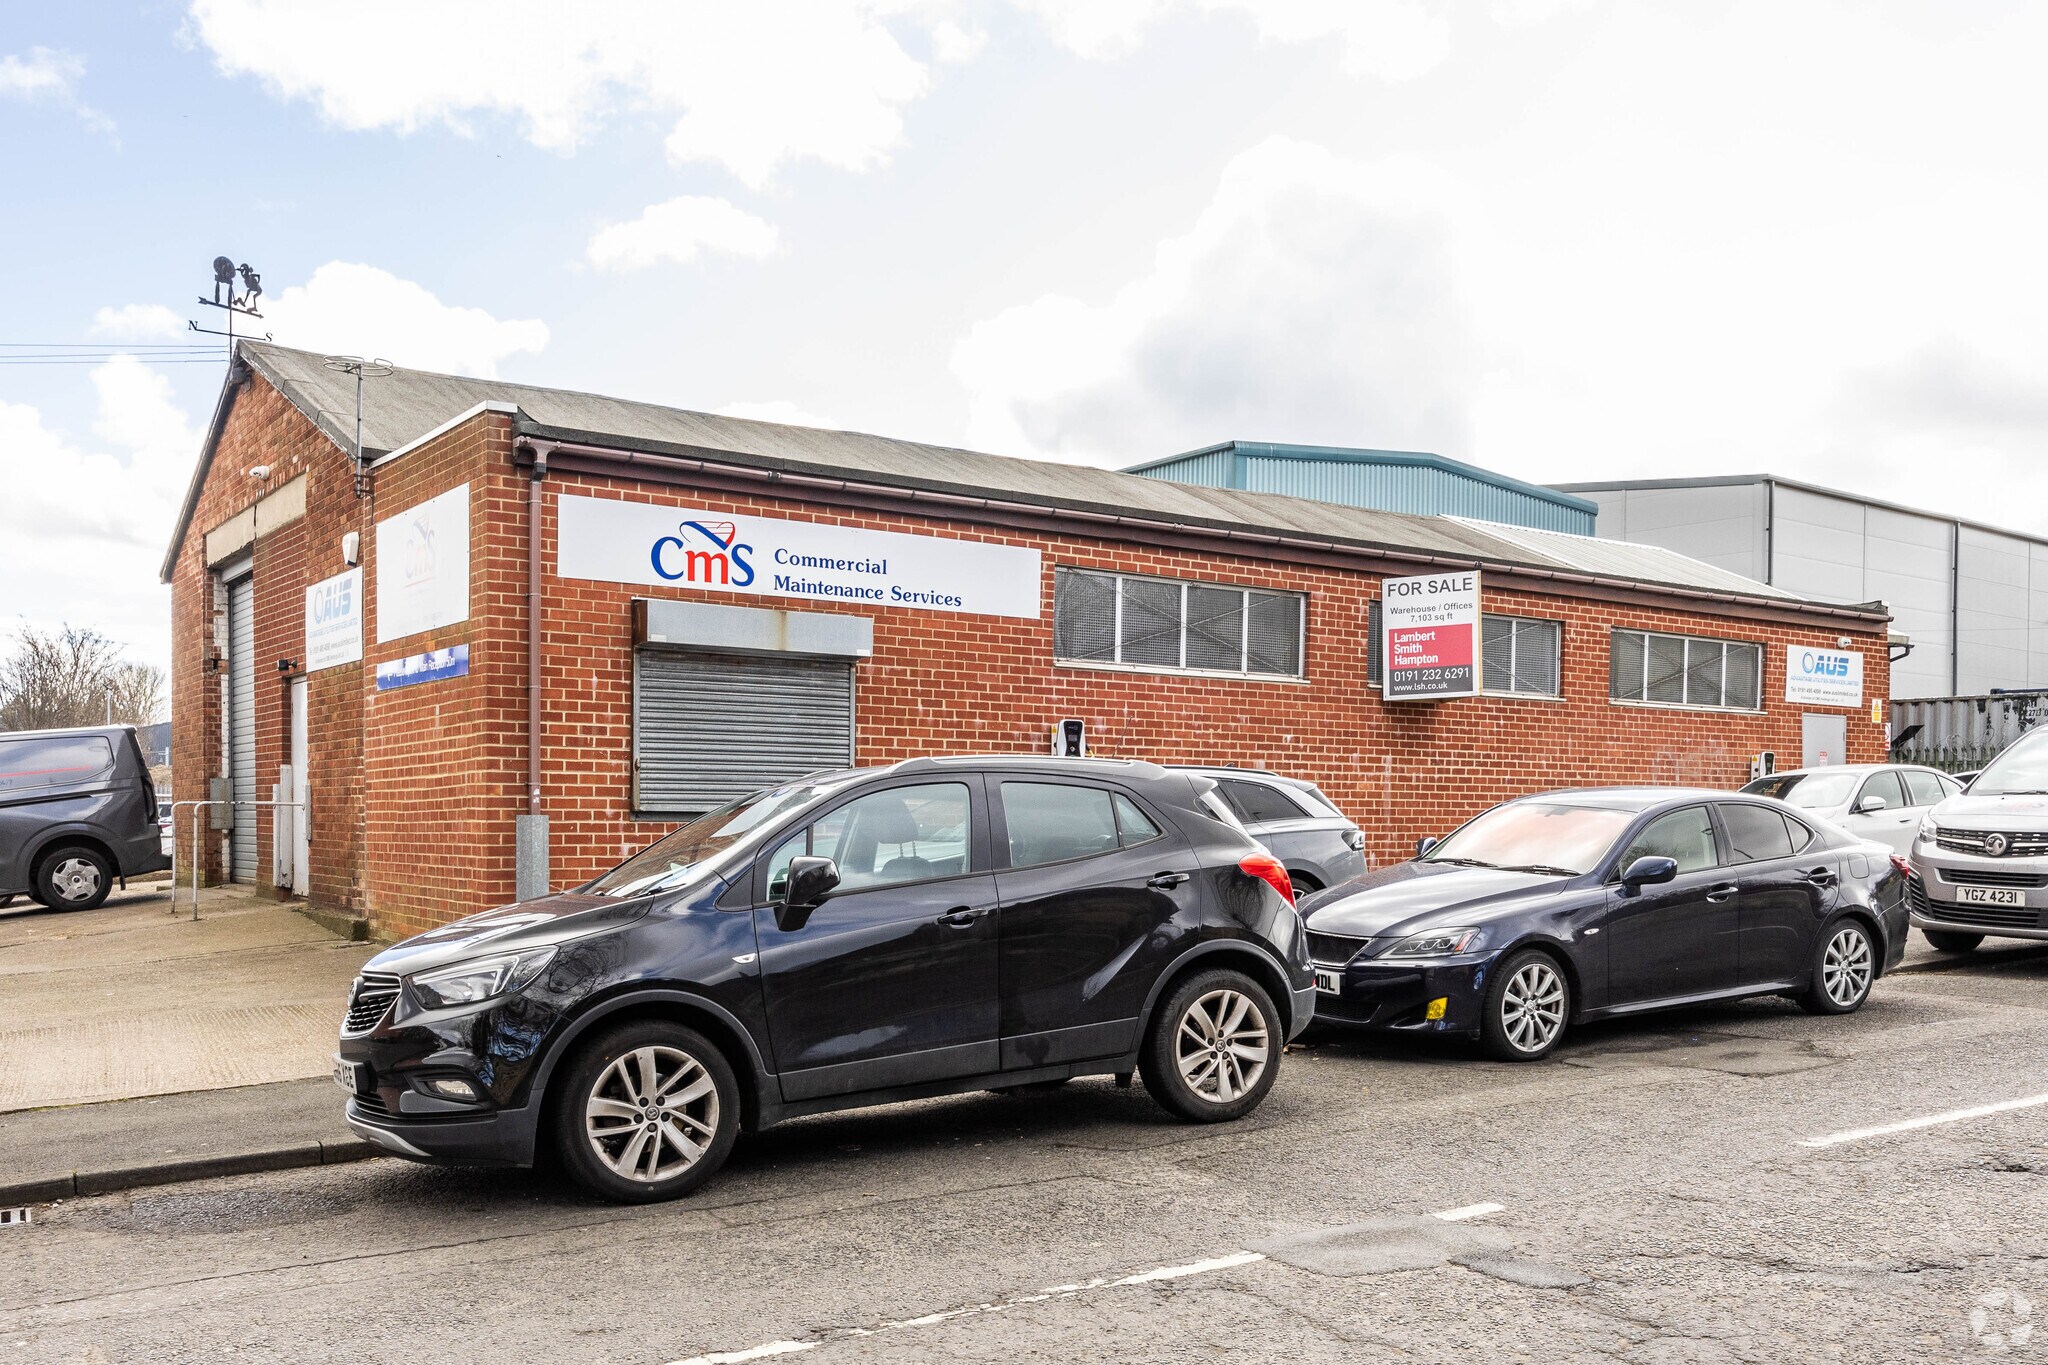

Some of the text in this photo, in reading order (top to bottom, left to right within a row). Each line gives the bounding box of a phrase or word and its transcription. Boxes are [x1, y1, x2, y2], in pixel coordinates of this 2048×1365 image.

[774, 548, 887, 574] Commercial
[773, 574, 962, 607] Maintenance Services
[1387, 577, 1473, 597] FOR SALE
[1390, 605, 1436, 615] Warehouse
[1444, 602, 1473, 611] Offices
[1410, 614, 1432, 624] 7,103
[1447, 612, 1453, 620] ft
[1394, 631, 1435, 642] Lambert
[1394, 643, 1422, 654] Smith
[1394, 654, 1438, 666] Hampton
[1394, 668, 1469, 682] 0191 232 6291
[1394, 681, 1448, 691] www.lsh.co.uk
[1964, 889, 2017, 903] YGZ 4231
